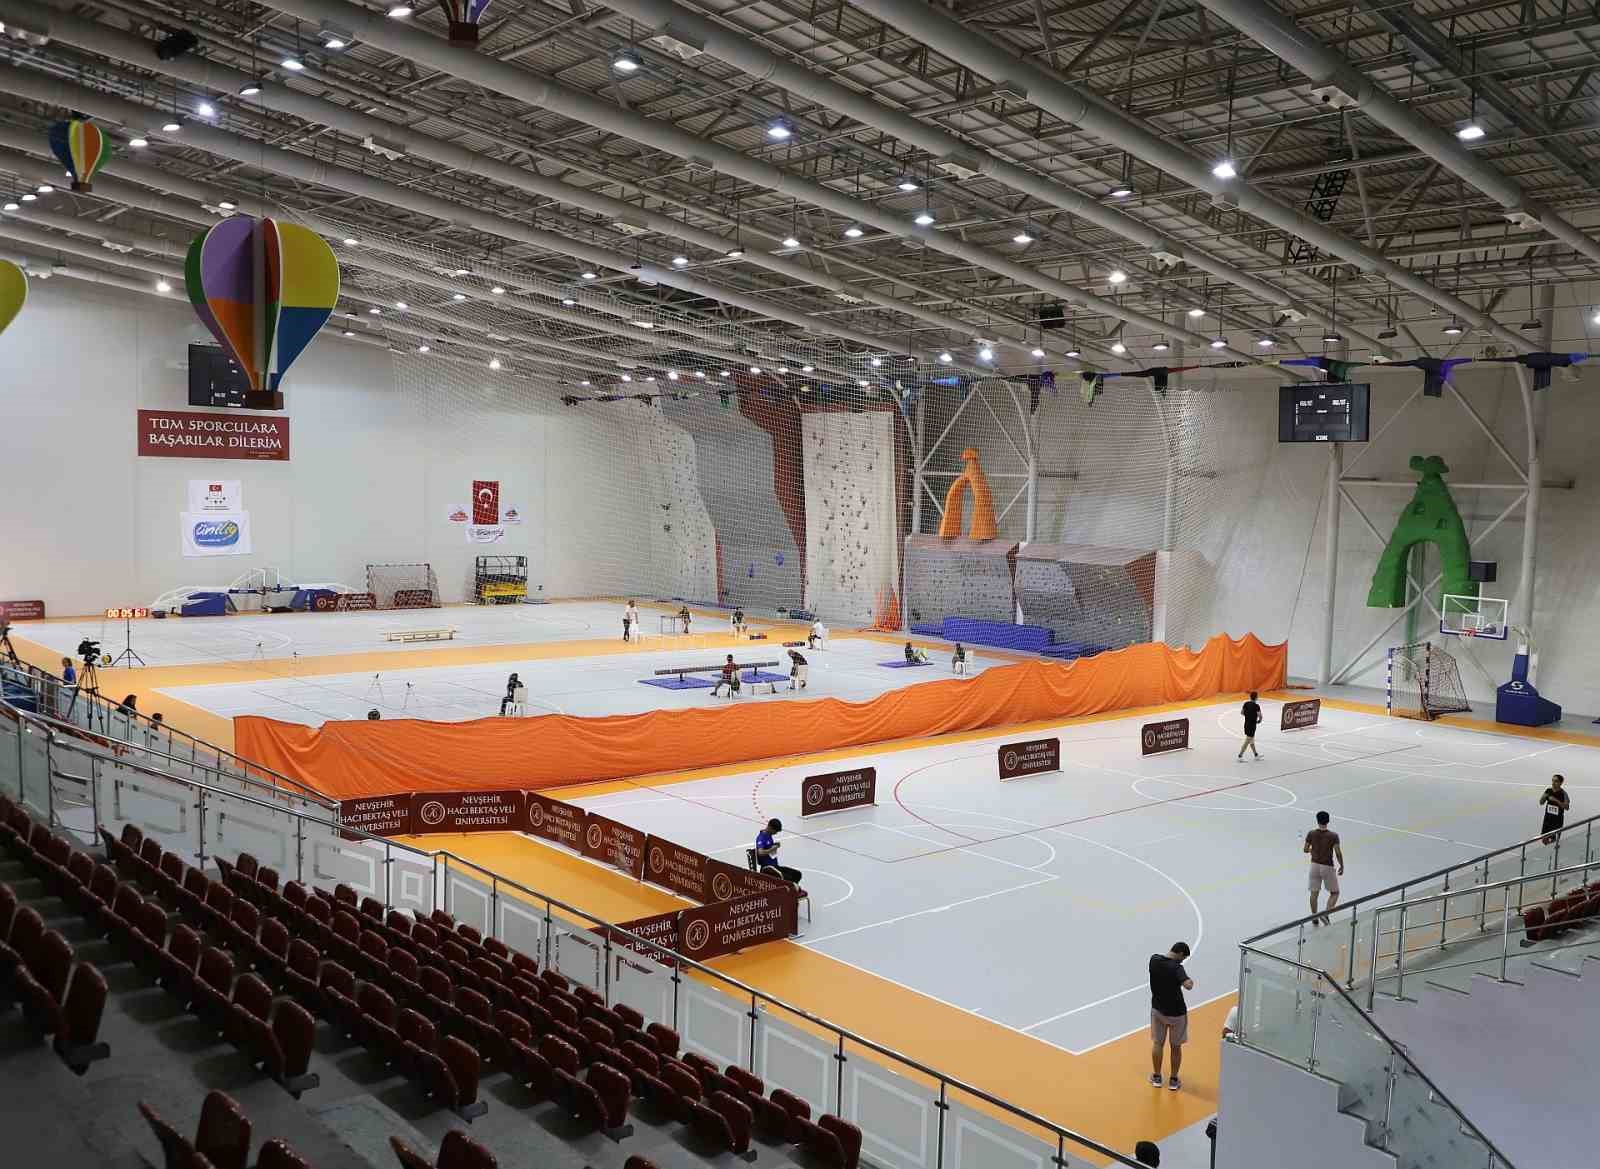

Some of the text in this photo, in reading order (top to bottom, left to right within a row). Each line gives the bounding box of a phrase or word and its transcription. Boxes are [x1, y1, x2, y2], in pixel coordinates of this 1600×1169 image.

[188, 419, 278, 434] SPORCULARA
[149, 433, 282, 449] BAŞARILAR DİLERİM
[355, 800, 394, 811] NEVŞEHİR
[462, 794, 501, 805] NEVŞEHİR
[340, 808, 409, 824] HACI BEKTAŞ VELİ
[447, 804, 516, 815] HACI BEKTAŞ VELİ
[455, 815, 508, 825] ÜNİVERSİTESİ
[729, 898, 769, 916] NEVŞEHİR
[714, 906, 782, 933] HACI BEKTAŞ VELİ
[722, 921, 775, 945] ÜNİVERSİTESİ
